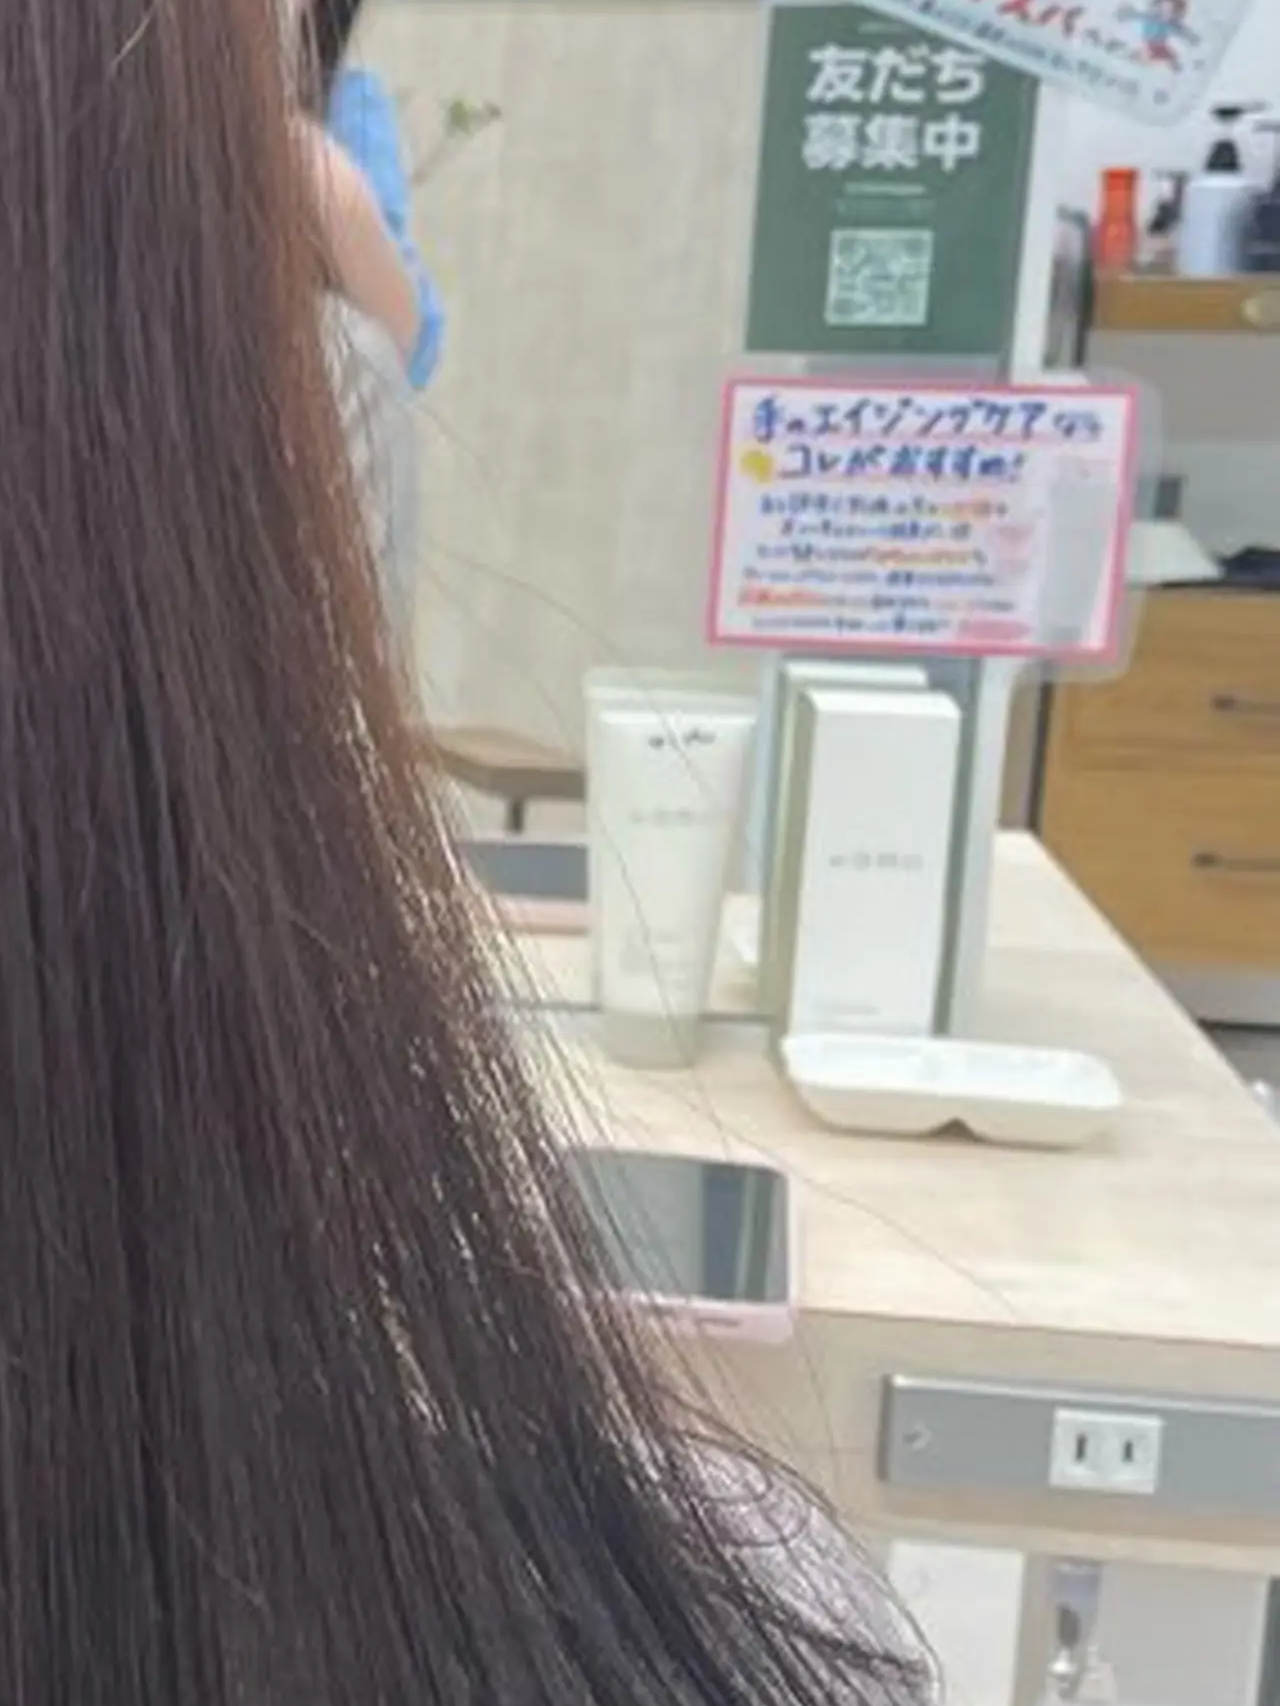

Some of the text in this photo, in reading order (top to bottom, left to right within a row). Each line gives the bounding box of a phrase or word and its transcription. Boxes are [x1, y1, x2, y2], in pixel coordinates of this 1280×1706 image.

[806, 42, 988, 104] 友だち
[801, 111, 982, 173] 募集中
